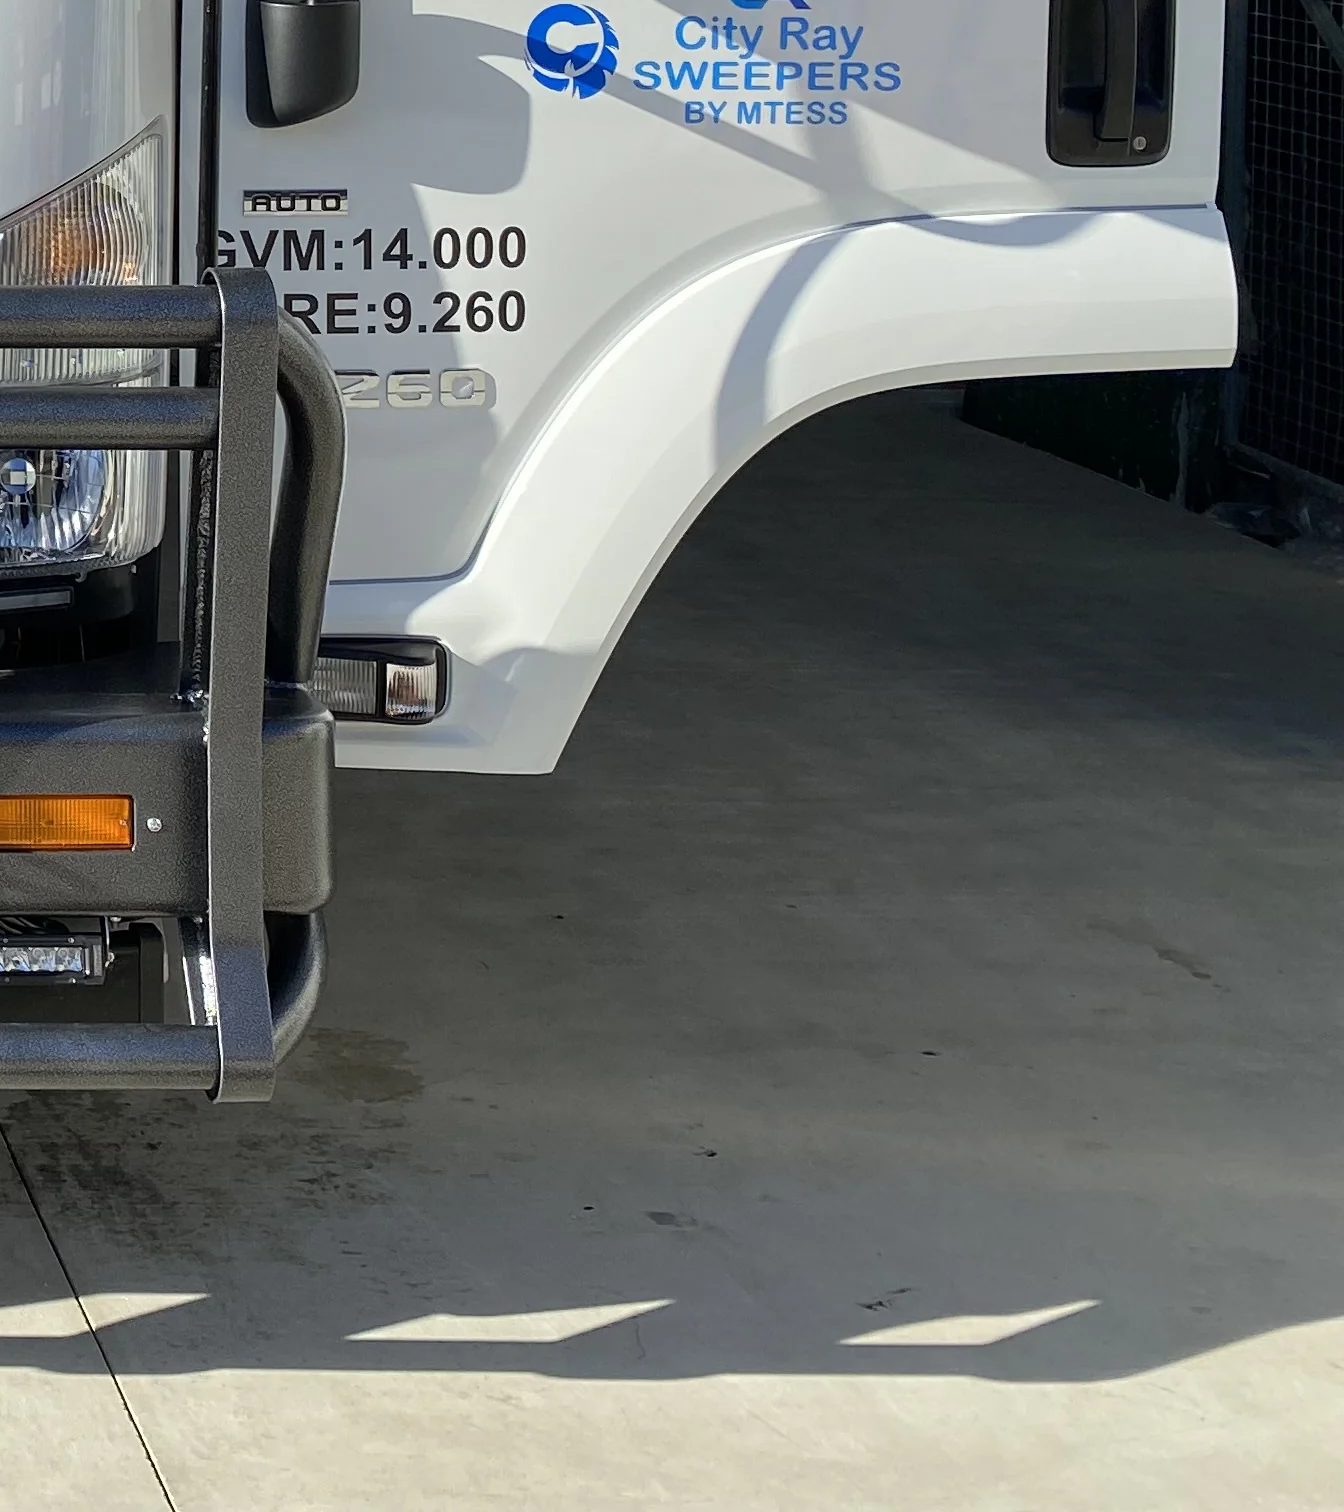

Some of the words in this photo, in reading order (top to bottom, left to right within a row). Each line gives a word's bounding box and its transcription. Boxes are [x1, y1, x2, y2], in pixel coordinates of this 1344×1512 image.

[675, 15, 764, 59] City
[779, 16, 864, 60] Ray
[632, 61, 902, 92] SWEEPERS
[684, 101, 727, 125] BY
[737, 101, 848, 125] MTESS
[251, 193, 341, 212] AUTO
[283, 290, 526, 335] RE:9.260
